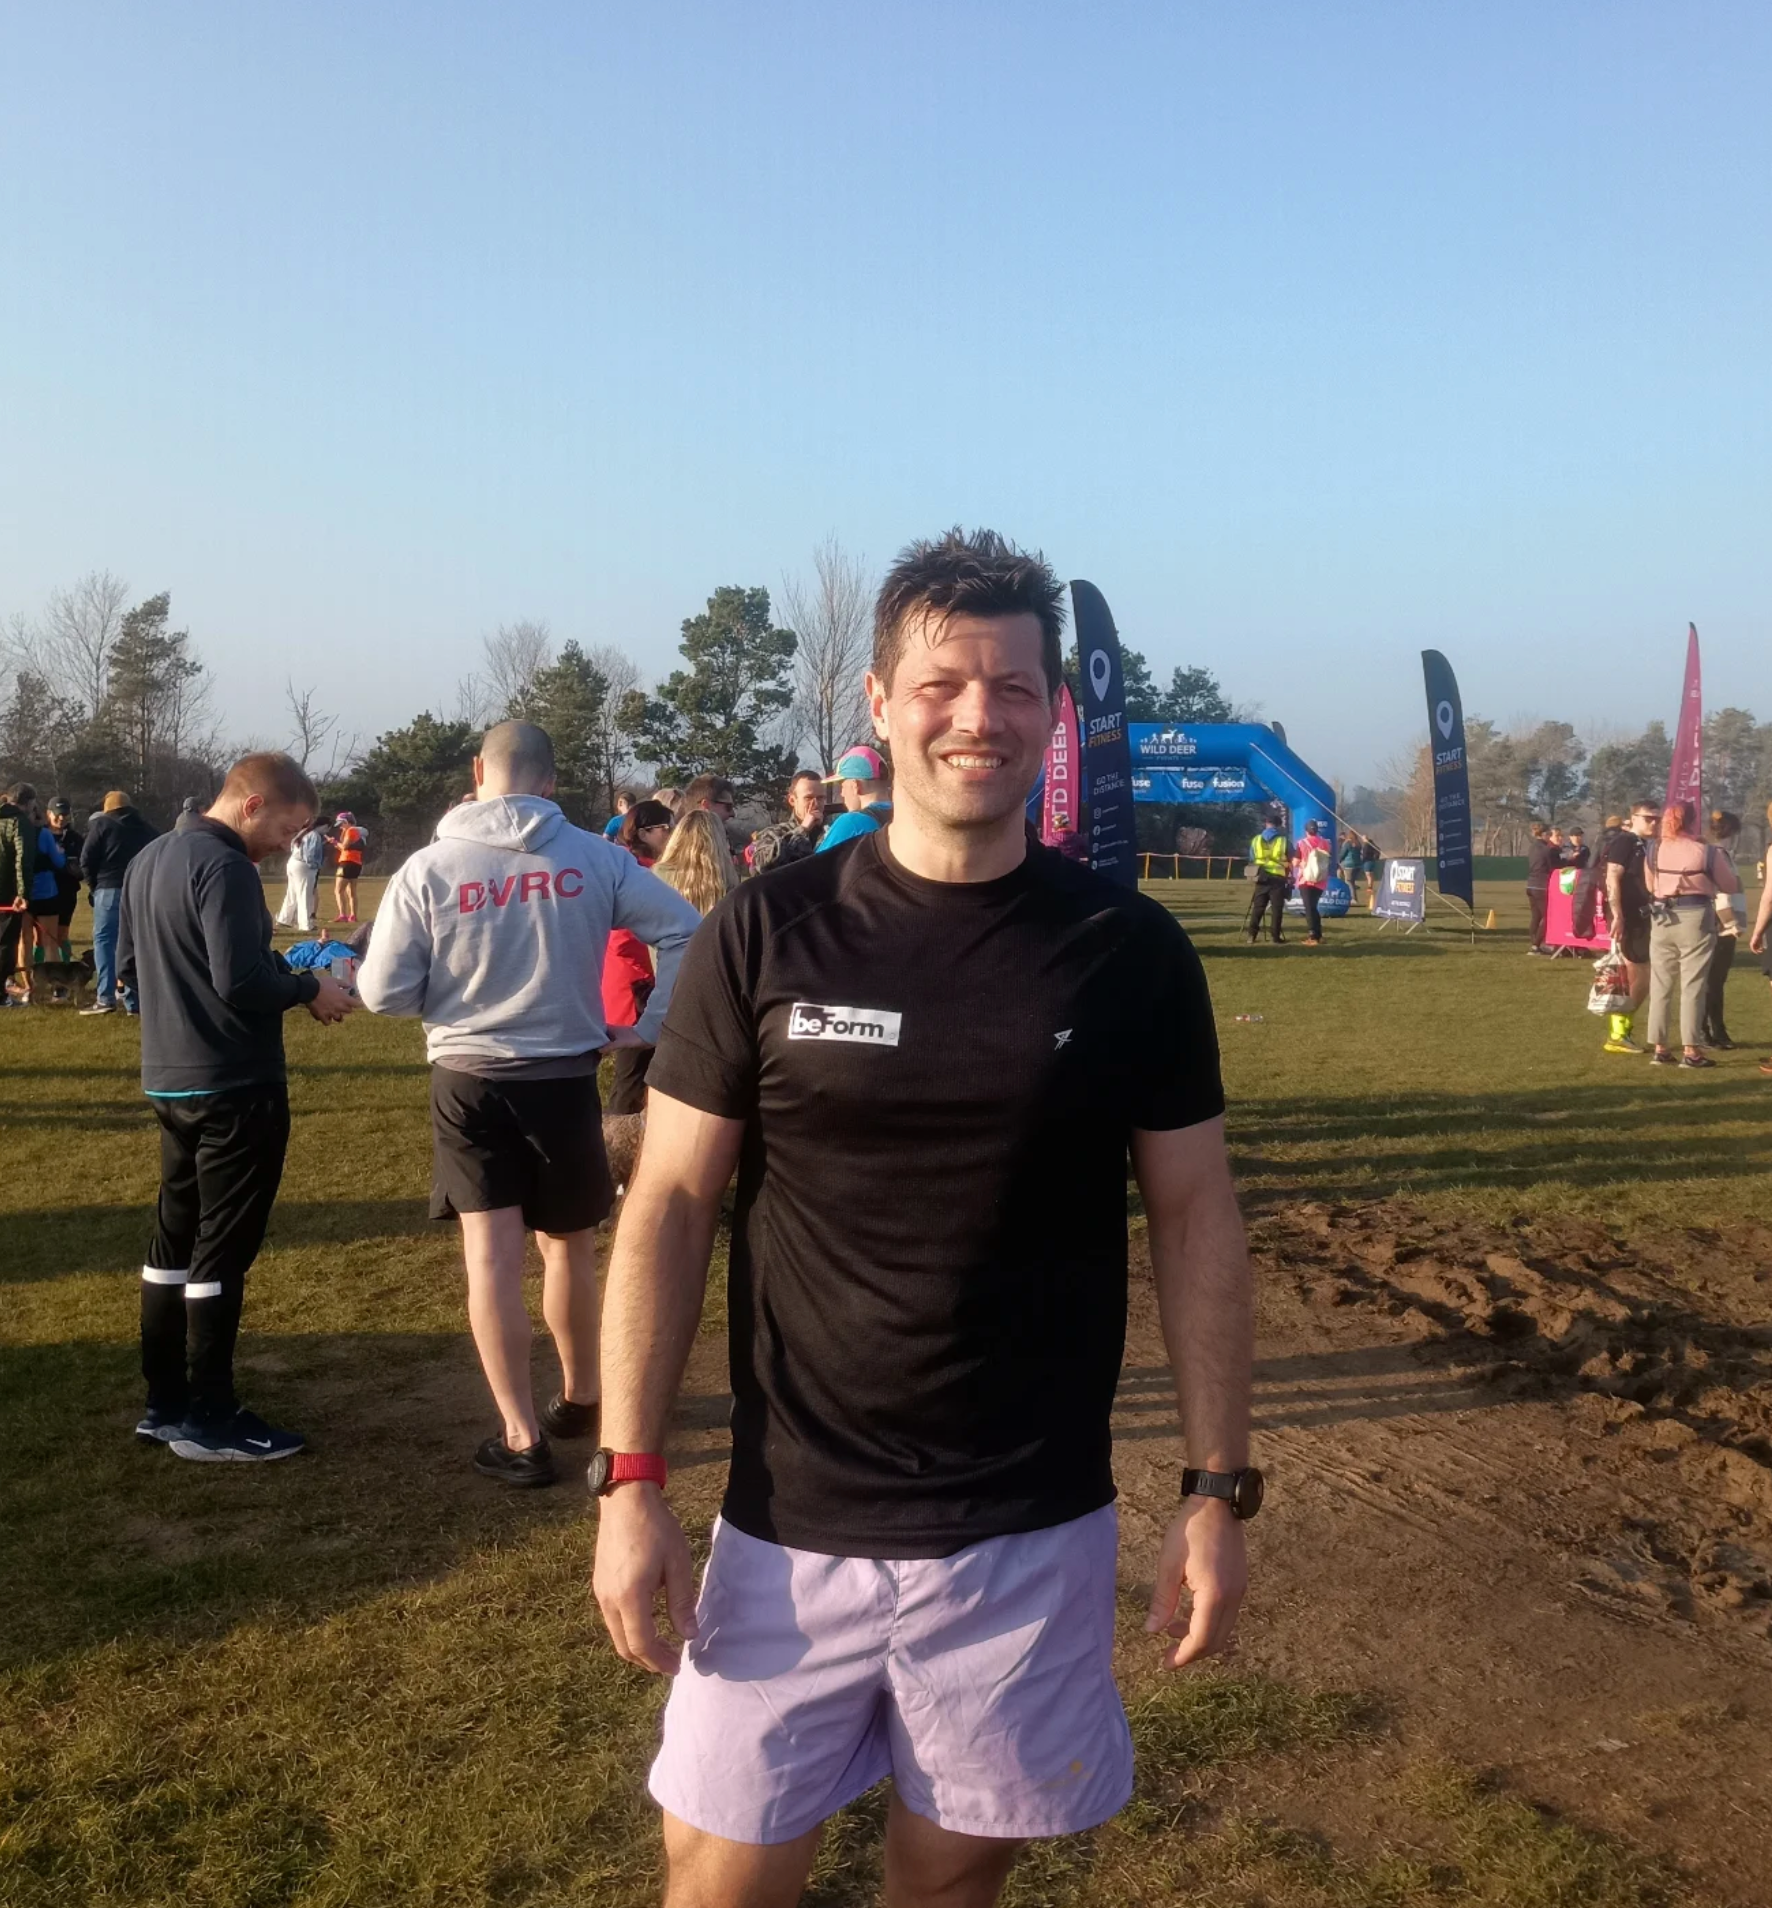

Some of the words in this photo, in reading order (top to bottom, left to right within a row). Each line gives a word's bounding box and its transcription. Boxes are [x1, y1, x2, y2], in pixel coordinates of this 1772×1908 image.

[1089, 712, 1122, 735] START
[1088, 728, 1122, 748] FITNESS
[1139, 744, 1166, 755] WILD
[1169, 744, 1197, 755] DEER
[1436, 747, 1463, 765] START
[1181, 776, 1204, 789] fuse
[1212, 777, 1245, 788] fusion
[1397, 866, 1416, 881] START
[459, 867, 585, 914] DVRC
